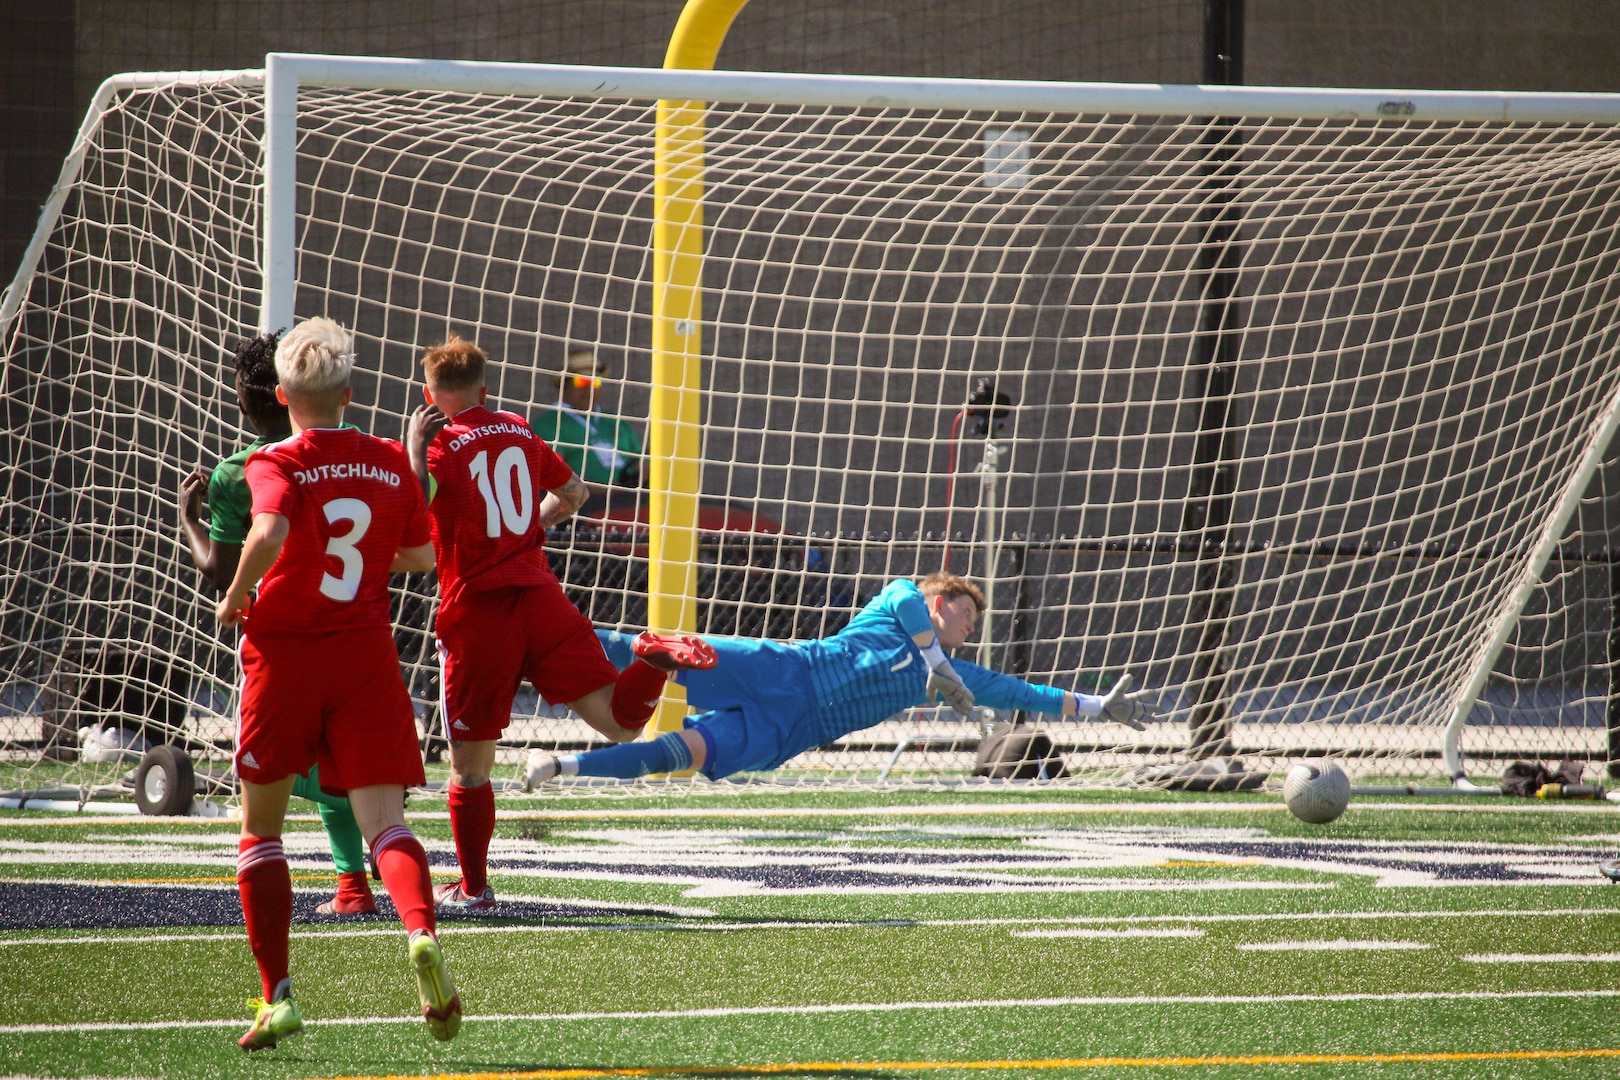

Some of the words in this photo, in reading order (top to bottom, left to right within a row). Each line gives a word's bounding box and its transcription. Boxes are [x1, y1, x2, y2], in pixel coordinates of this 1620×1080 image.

[448, 422, 533, 452] DEUTSCHLAND
[293, 463, 401, 487] DUTSCHLAND
[469, 446, 534, 538] 10
[319, 498, 372, 602] 3
